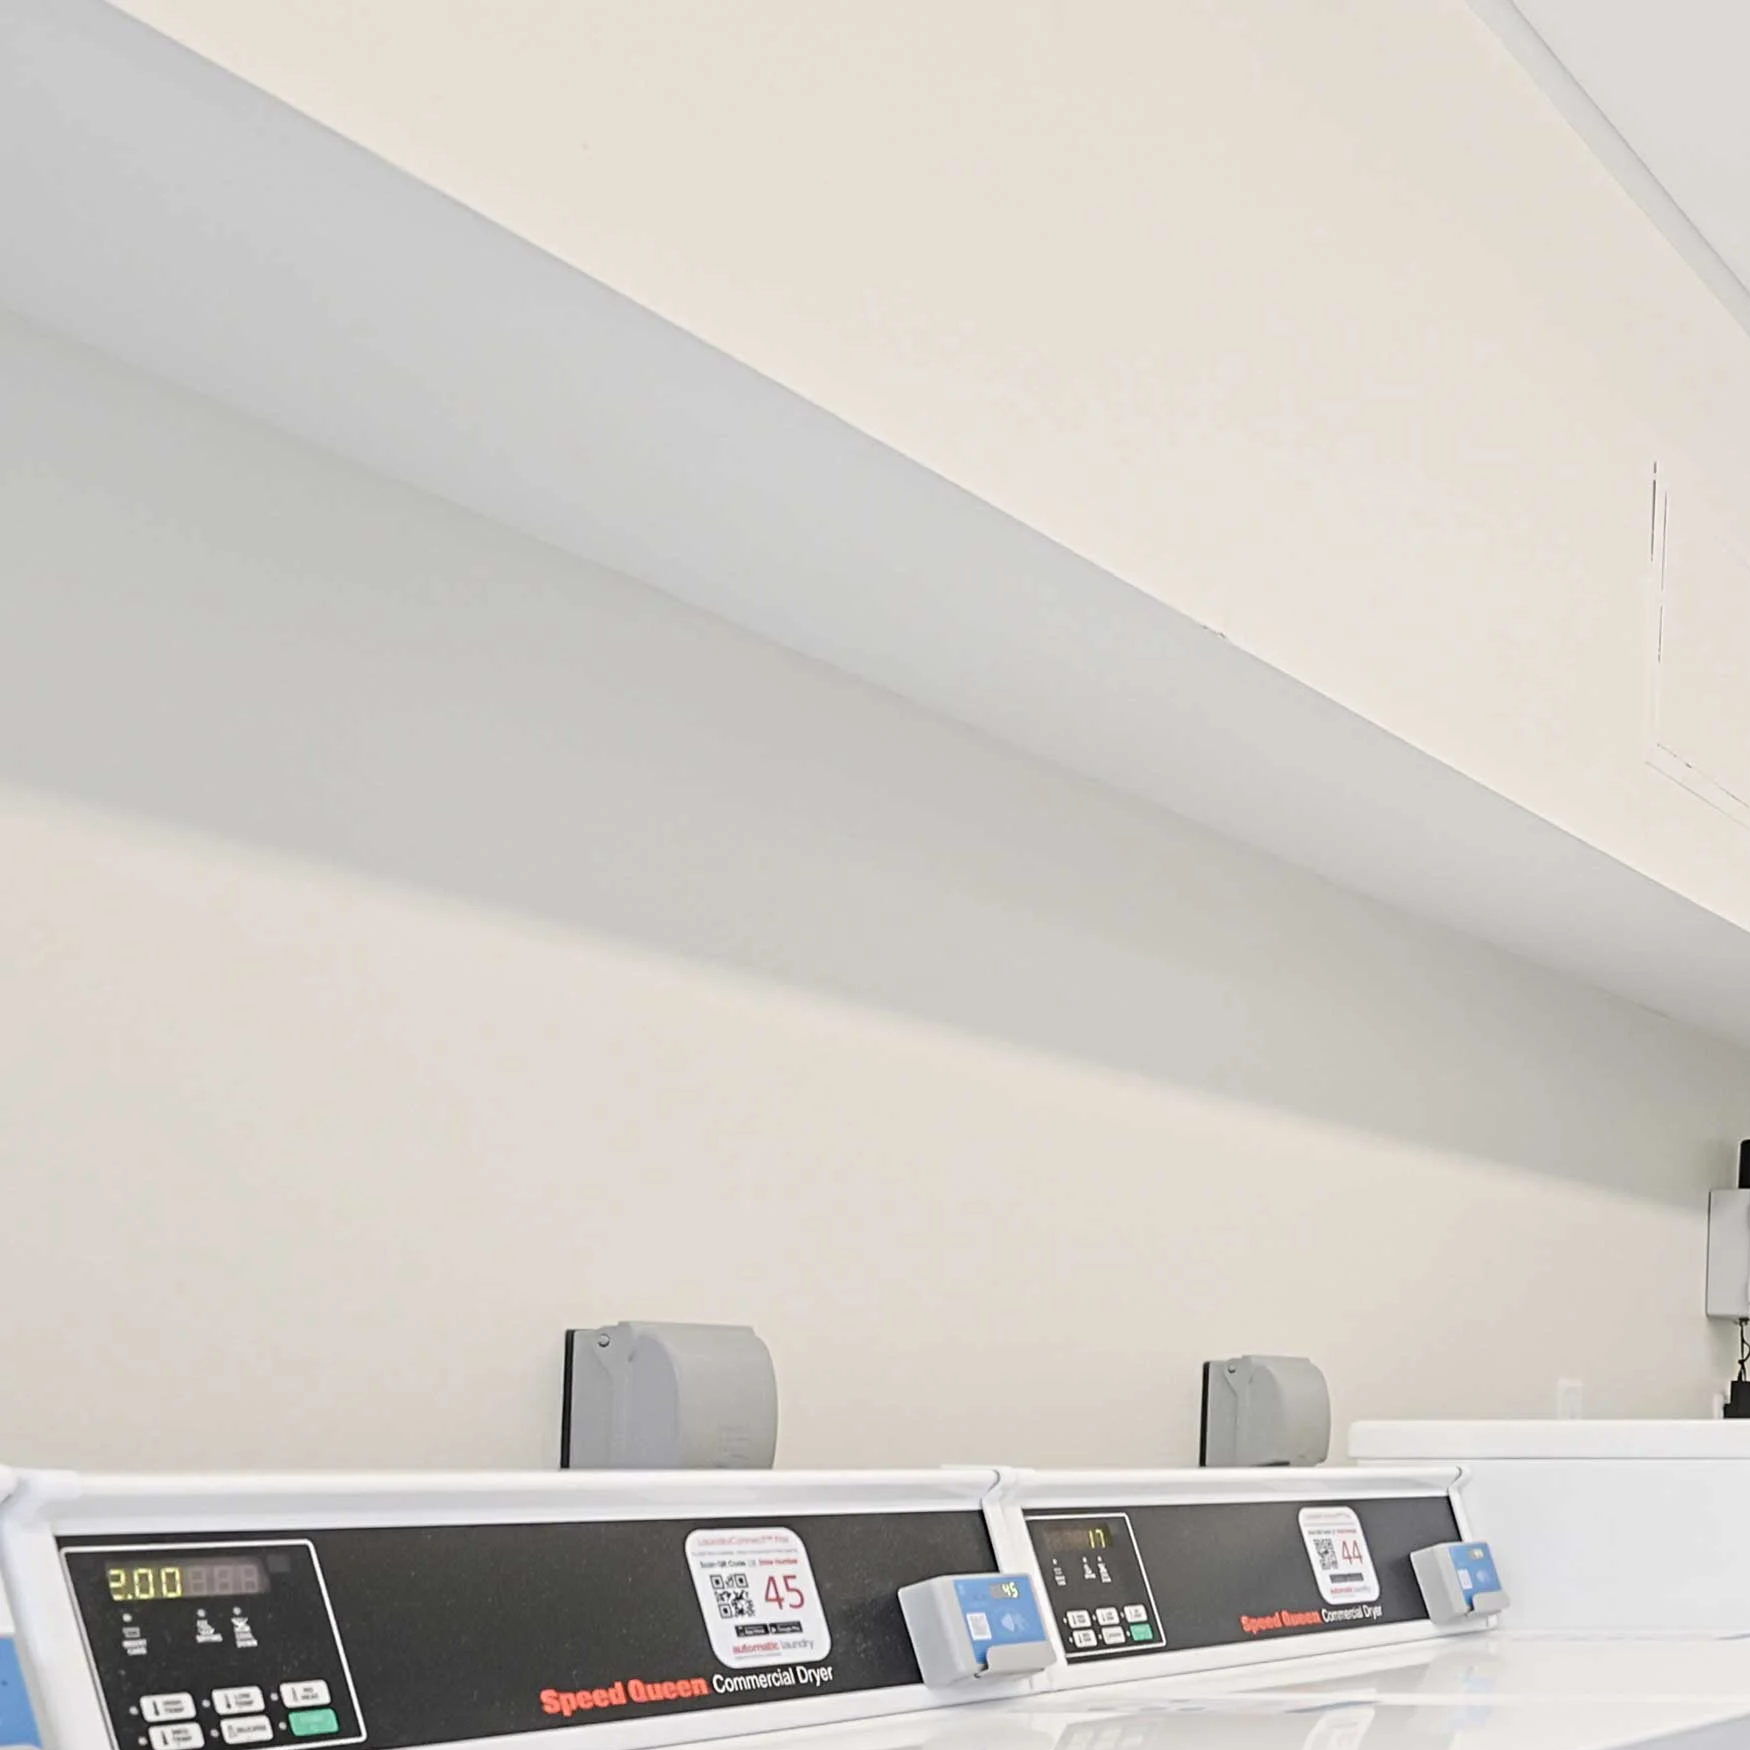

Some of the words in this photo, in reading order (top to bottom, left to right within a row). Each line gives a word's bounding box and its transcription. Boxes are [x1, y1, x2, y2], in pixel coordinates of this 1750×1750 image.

[1088, 1528, 1106, 1549] 17
[1341, 1540, 1363, 1566] 44
[108, 1567, 182, 1601] 2.00
[764, 1574, 805, 1611] 45
[1001, 1581, 1019, 1598] 45
[1241, 1612, 1282, 1634] Speed
[1281, 1610, 1323, 1627] Queen
[1321, 1608, 1363, 1623] Commercial
[1363, 1605, 1382, 1620] Dryer
[539, 1682, 627, 1717] Speed
[627, 1677, 709, 1704] Queen
[712, 1667, 795, 1694] Commercial
[796, 1665, 833, 1687] Dryer
